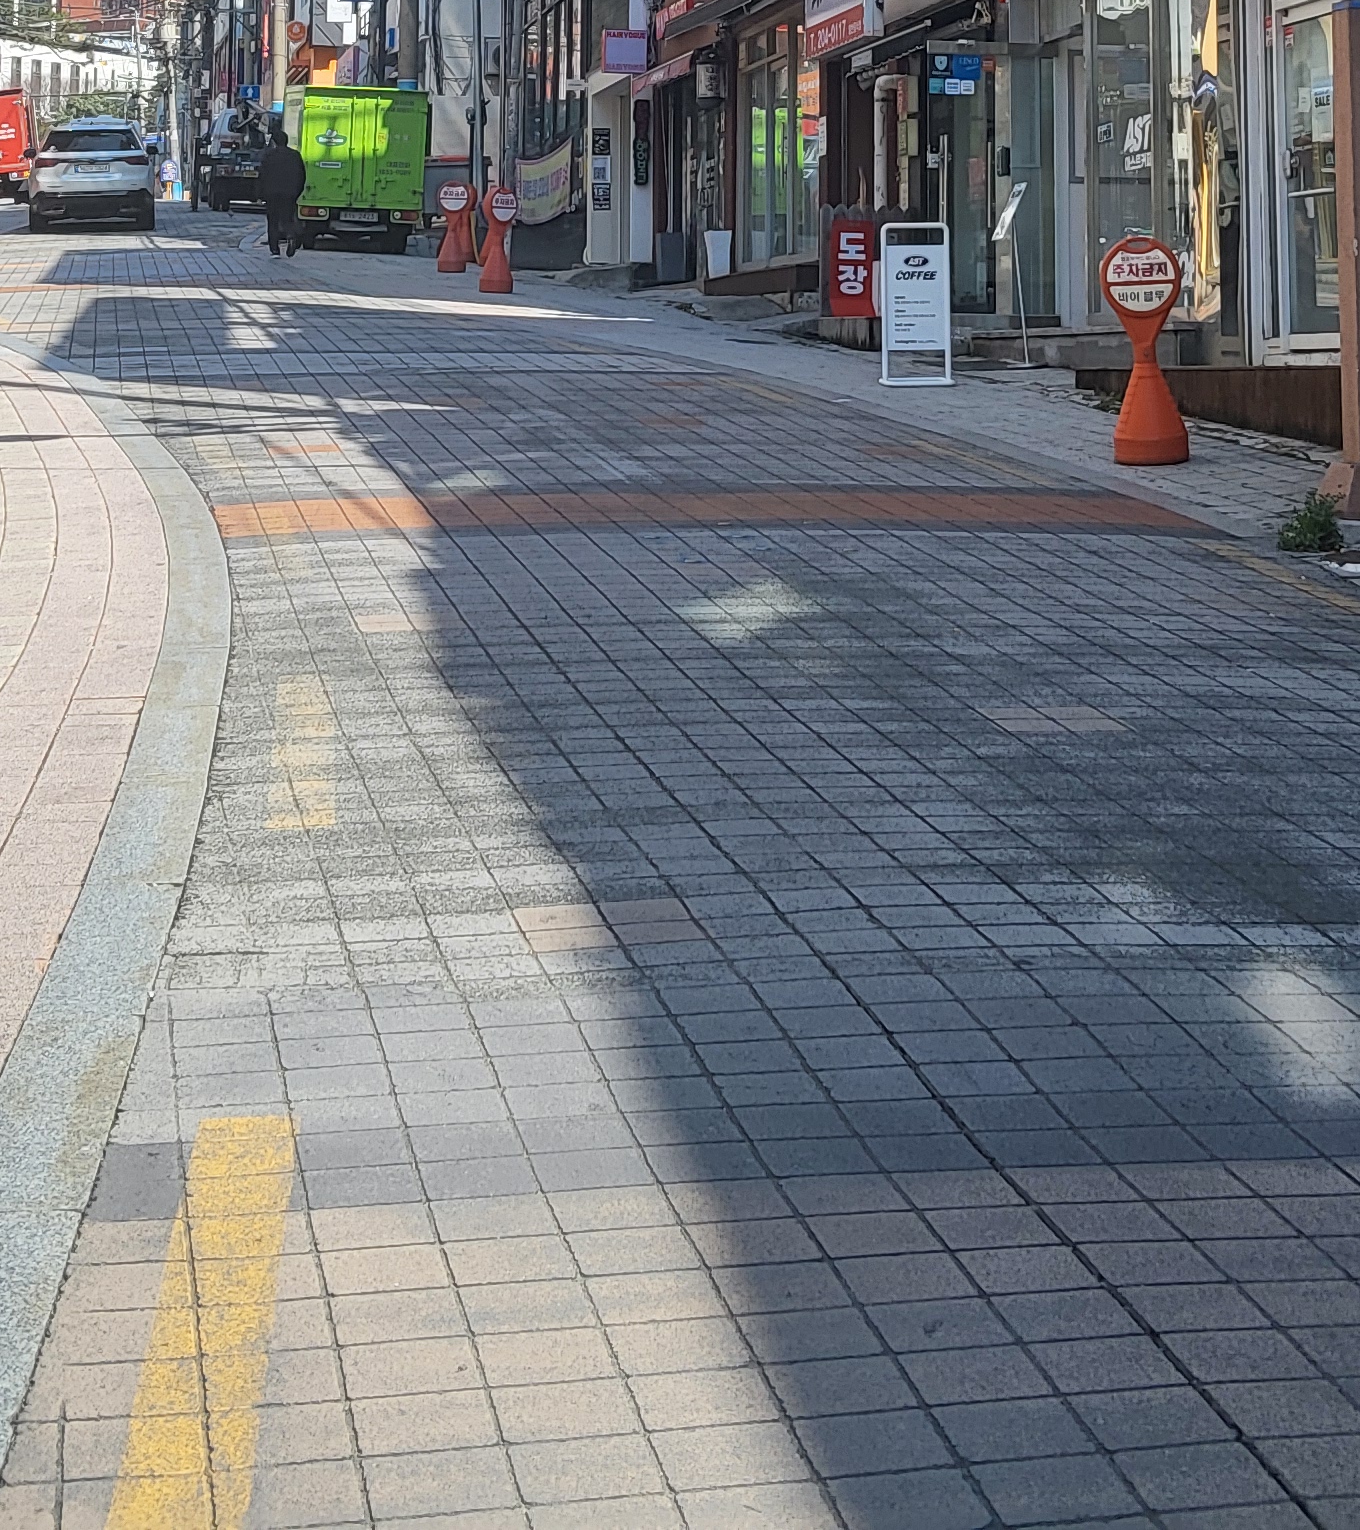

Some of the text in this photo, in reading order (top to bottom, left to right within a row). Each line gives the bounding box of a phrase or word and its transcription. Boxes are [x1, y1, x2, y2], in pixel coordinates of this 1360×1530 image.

[606, 31, 624, 39] HAIR
[817, 18, 847, 49] 204-0117
[1314, 94, 1331, 108] SALE
[1124, 113, 1152, 153] AST
[837, 230, 868, 296] 도장
[908, 257, 925, 266] AST
[895, 270, 938, 281] COFFEE
[1112, 262, 1169, 279] 주차금지
[1117, 289, 1166, 303] 바이 블루
